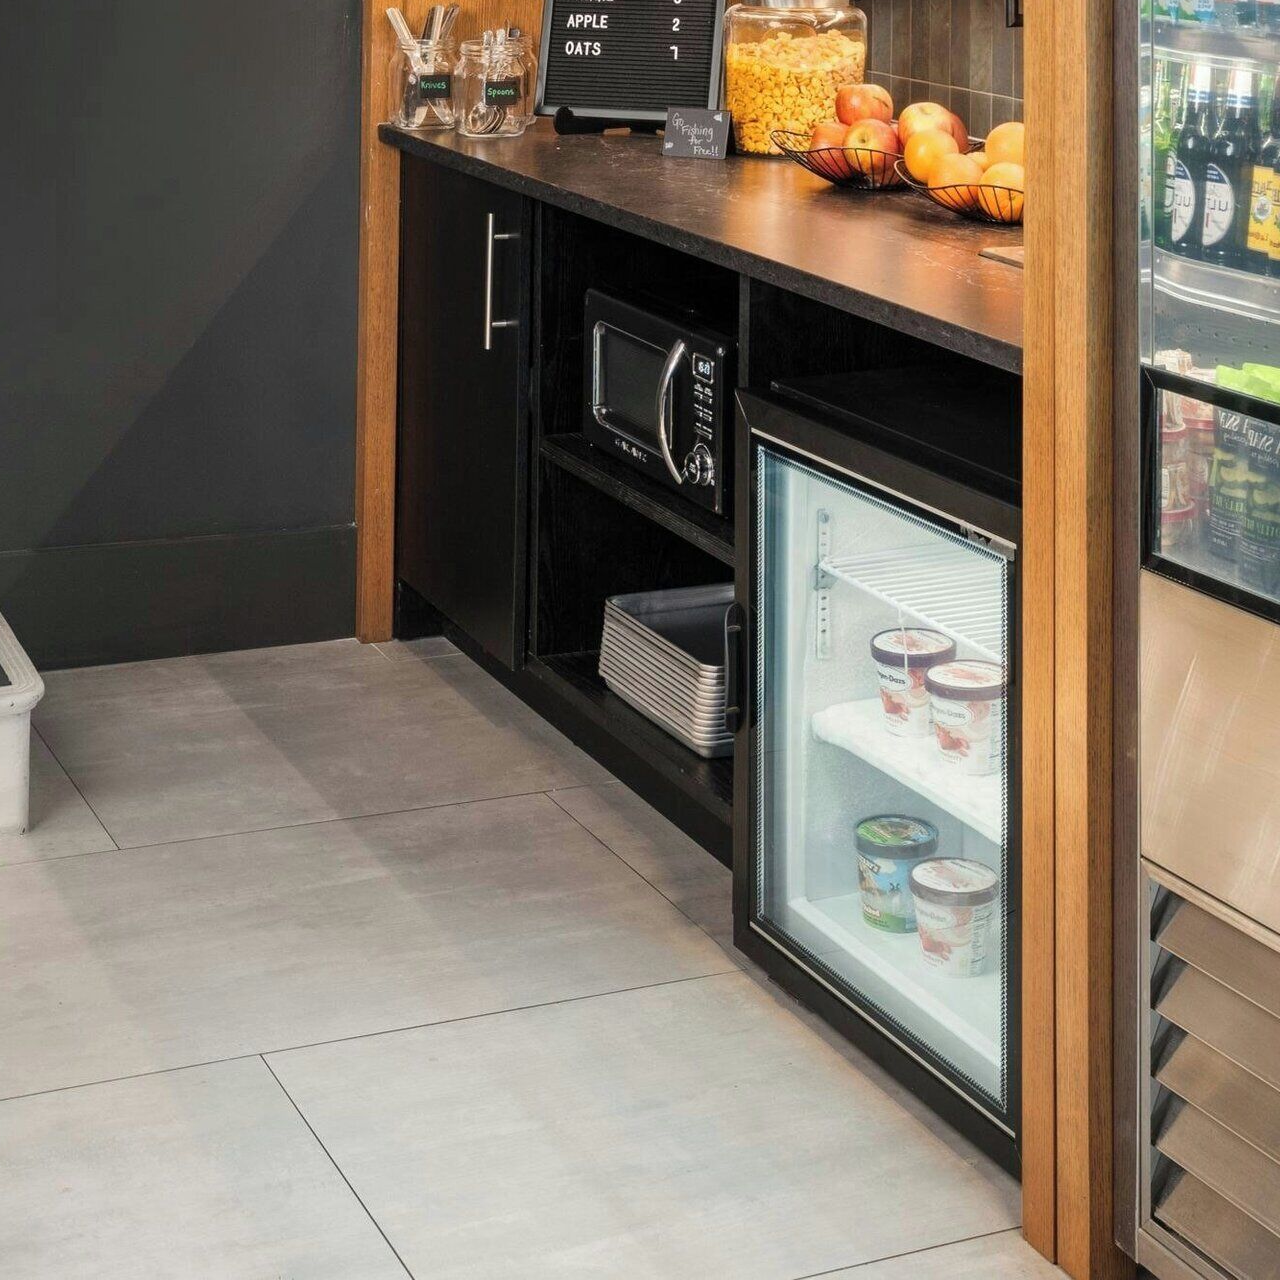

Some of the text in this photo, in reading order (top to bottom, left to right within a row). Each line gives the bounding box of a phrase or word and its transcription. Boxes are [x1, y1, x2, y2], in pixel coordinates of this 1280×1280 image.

[567, 14, 680, 32] APPLE 2
[565, 41, 678, 60] OATS 7
[420, 81, 447, 89] Knives
[487, 87, 514, 97] Spoons
[672, 112, 685, 129] Go
[681, 123, 714, 142] Fishing
[688, 134, 703, 146] for
[693, 145, 719, 157] Free!!
